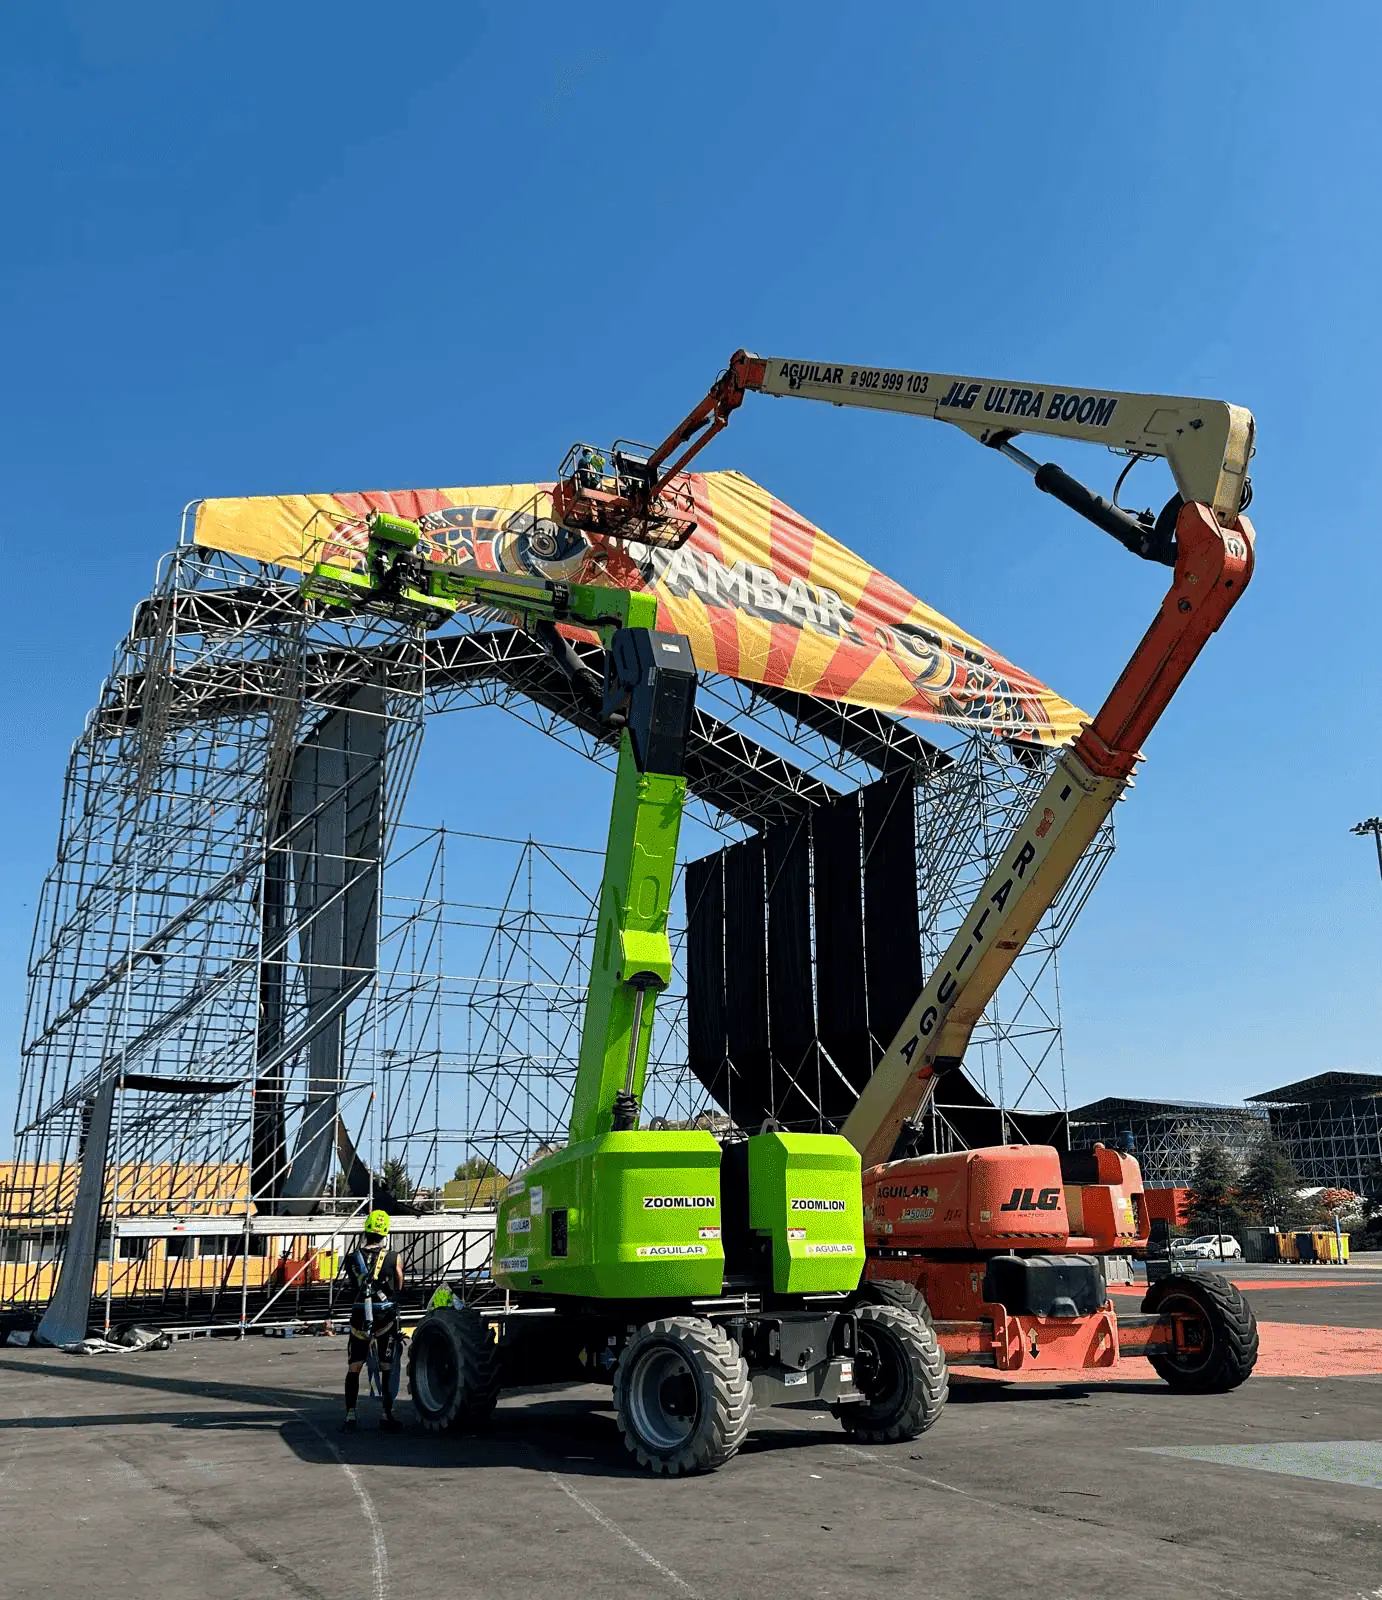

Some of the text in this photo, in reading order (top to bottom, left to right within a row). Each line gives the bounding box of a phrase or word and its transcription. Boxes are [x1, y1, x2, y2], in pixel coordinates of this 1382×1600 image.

[779, 363, 929, 393] AGUILAR 902 999 103
[939, 381, 1119, 427] JLG ULTRA BOOM
[898, 839, 1036, 1066] AGUILAR
[877, 1185, 929, 1198] AGUILAR
[644, 1197, 715, 1208] ZOOMLION
[791, 1200, 845, 1210] ZOOMLION
[649, 1246, 704, 1255] AGUILAR
[815, 1245, 853, 1253] AGUILAR
